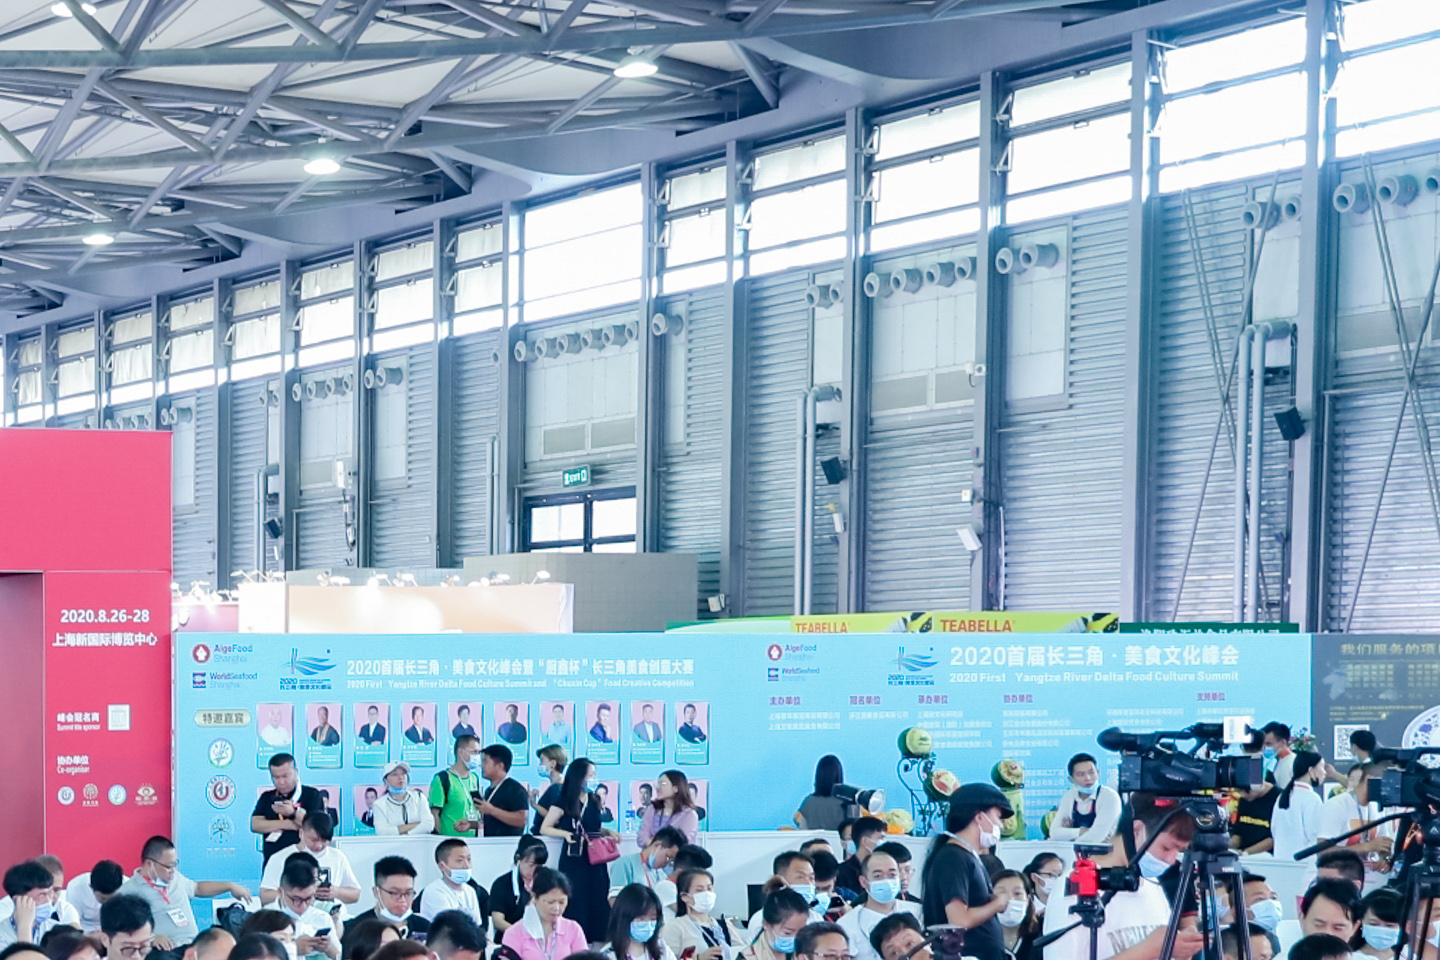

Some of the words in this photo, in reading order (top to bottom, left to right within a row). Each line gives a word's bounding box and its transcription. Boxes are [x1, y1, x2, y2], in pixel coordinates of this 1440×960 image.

[60, 609, 150, 623] 2020.8.26-28
[940, 619, 1012, 632] TEABELLA
[52, 632, 158, 647] 上海新国际博览中心
[1341, 643, 1440, 656] 我们服务的项
[949, 673, 978, 683] 2020
[980, 673, 1006, 682] First
[1015, 673, 1062, 684] Yangtze
[1063, 672, 1092, 682] River
[1094, 672, 1124, 682] Delta
[1126, 672, 1152, 682] Food
[1155, 671, 1195, 681] Culture
[1197, 671, 1239, 681] Summit
[202, 712, 244, 724] 特邀嘉宾
